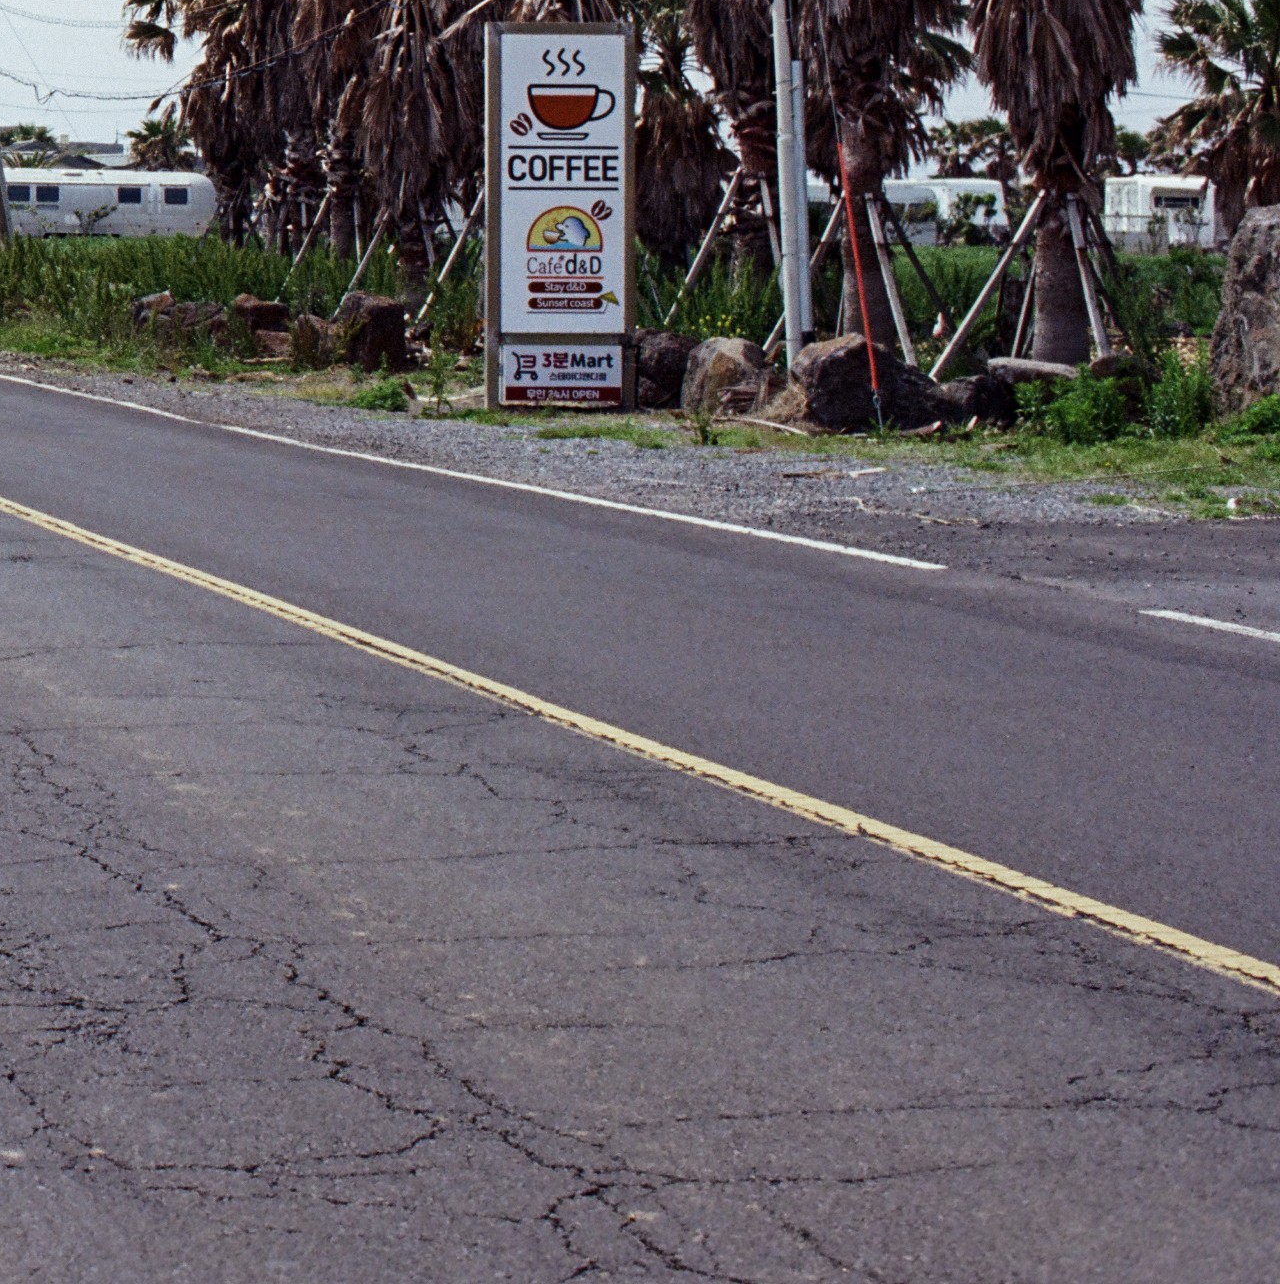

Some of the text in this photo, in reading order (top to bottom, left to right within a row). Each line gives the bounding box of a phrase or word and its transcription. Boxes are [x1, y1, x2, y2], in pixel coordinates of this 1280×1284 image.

[508, 154, 619, 181] COFFEE
[565, 253, 602, 275] d&D
[544, 282, 587, 293] Stay d&D
[536, 299, 594, 308] Sunset coast
[526, 389, 546, 400] 무인
[572, 389, 600, 400] OPEN
